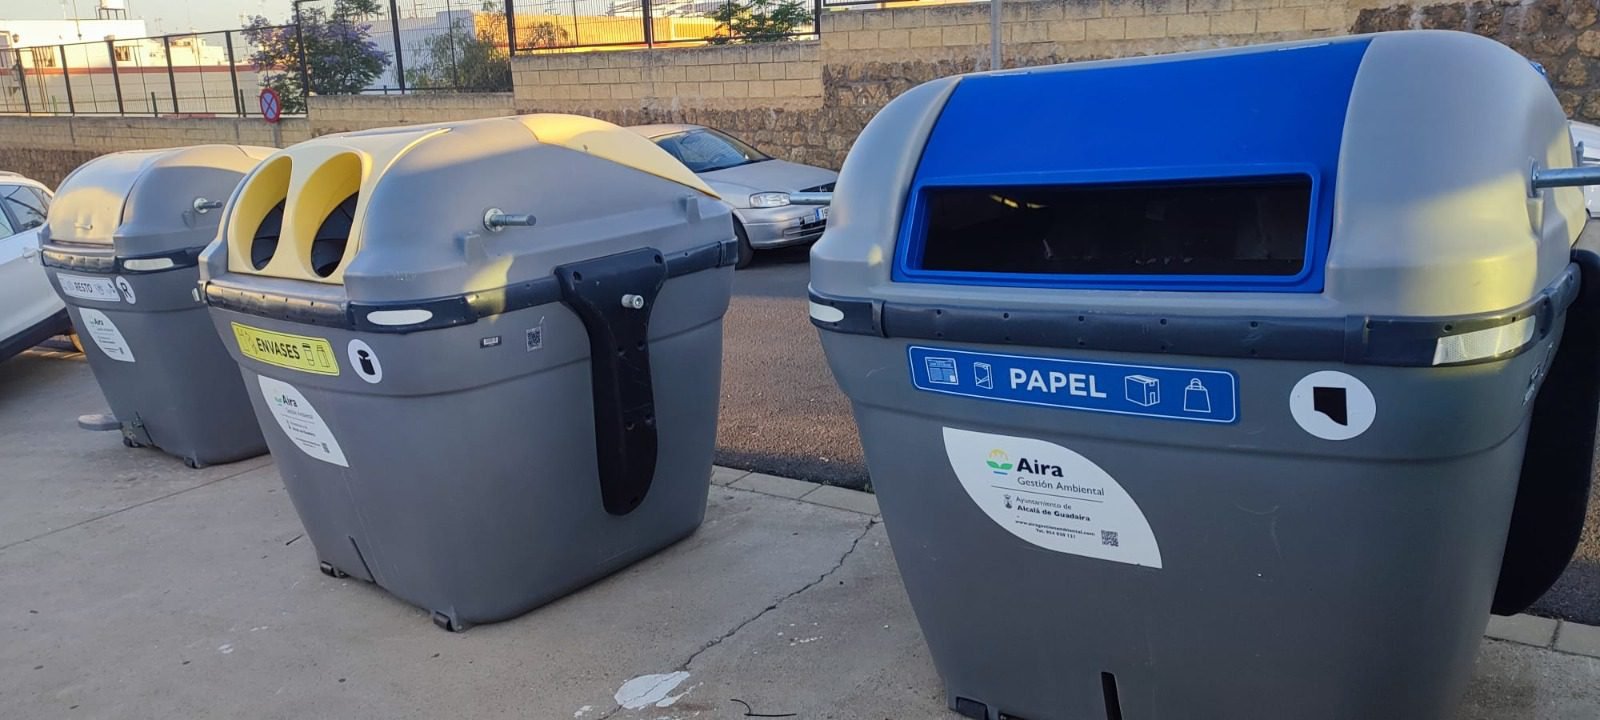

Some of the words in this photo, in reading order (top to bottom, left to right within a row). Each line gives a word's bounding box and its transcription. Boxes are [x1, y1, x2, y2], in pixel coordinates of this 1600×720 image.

[256, 337, 300, 359] ENVASES
[1009, 368, 1107, 399] PAPEL
[1016, 457, 1064, 477] Aira
[1017, 476, 1053, 489] Gestión
[1056, 481, 1105, 496] Ambiental
[1015, 496, 1061, 509] Ayuntamiento
[1016, 504, 1041, 514] Alcalá
[1042, 508, 1052, 516] de
[1053, 510, 1091, 522] Guadaira
